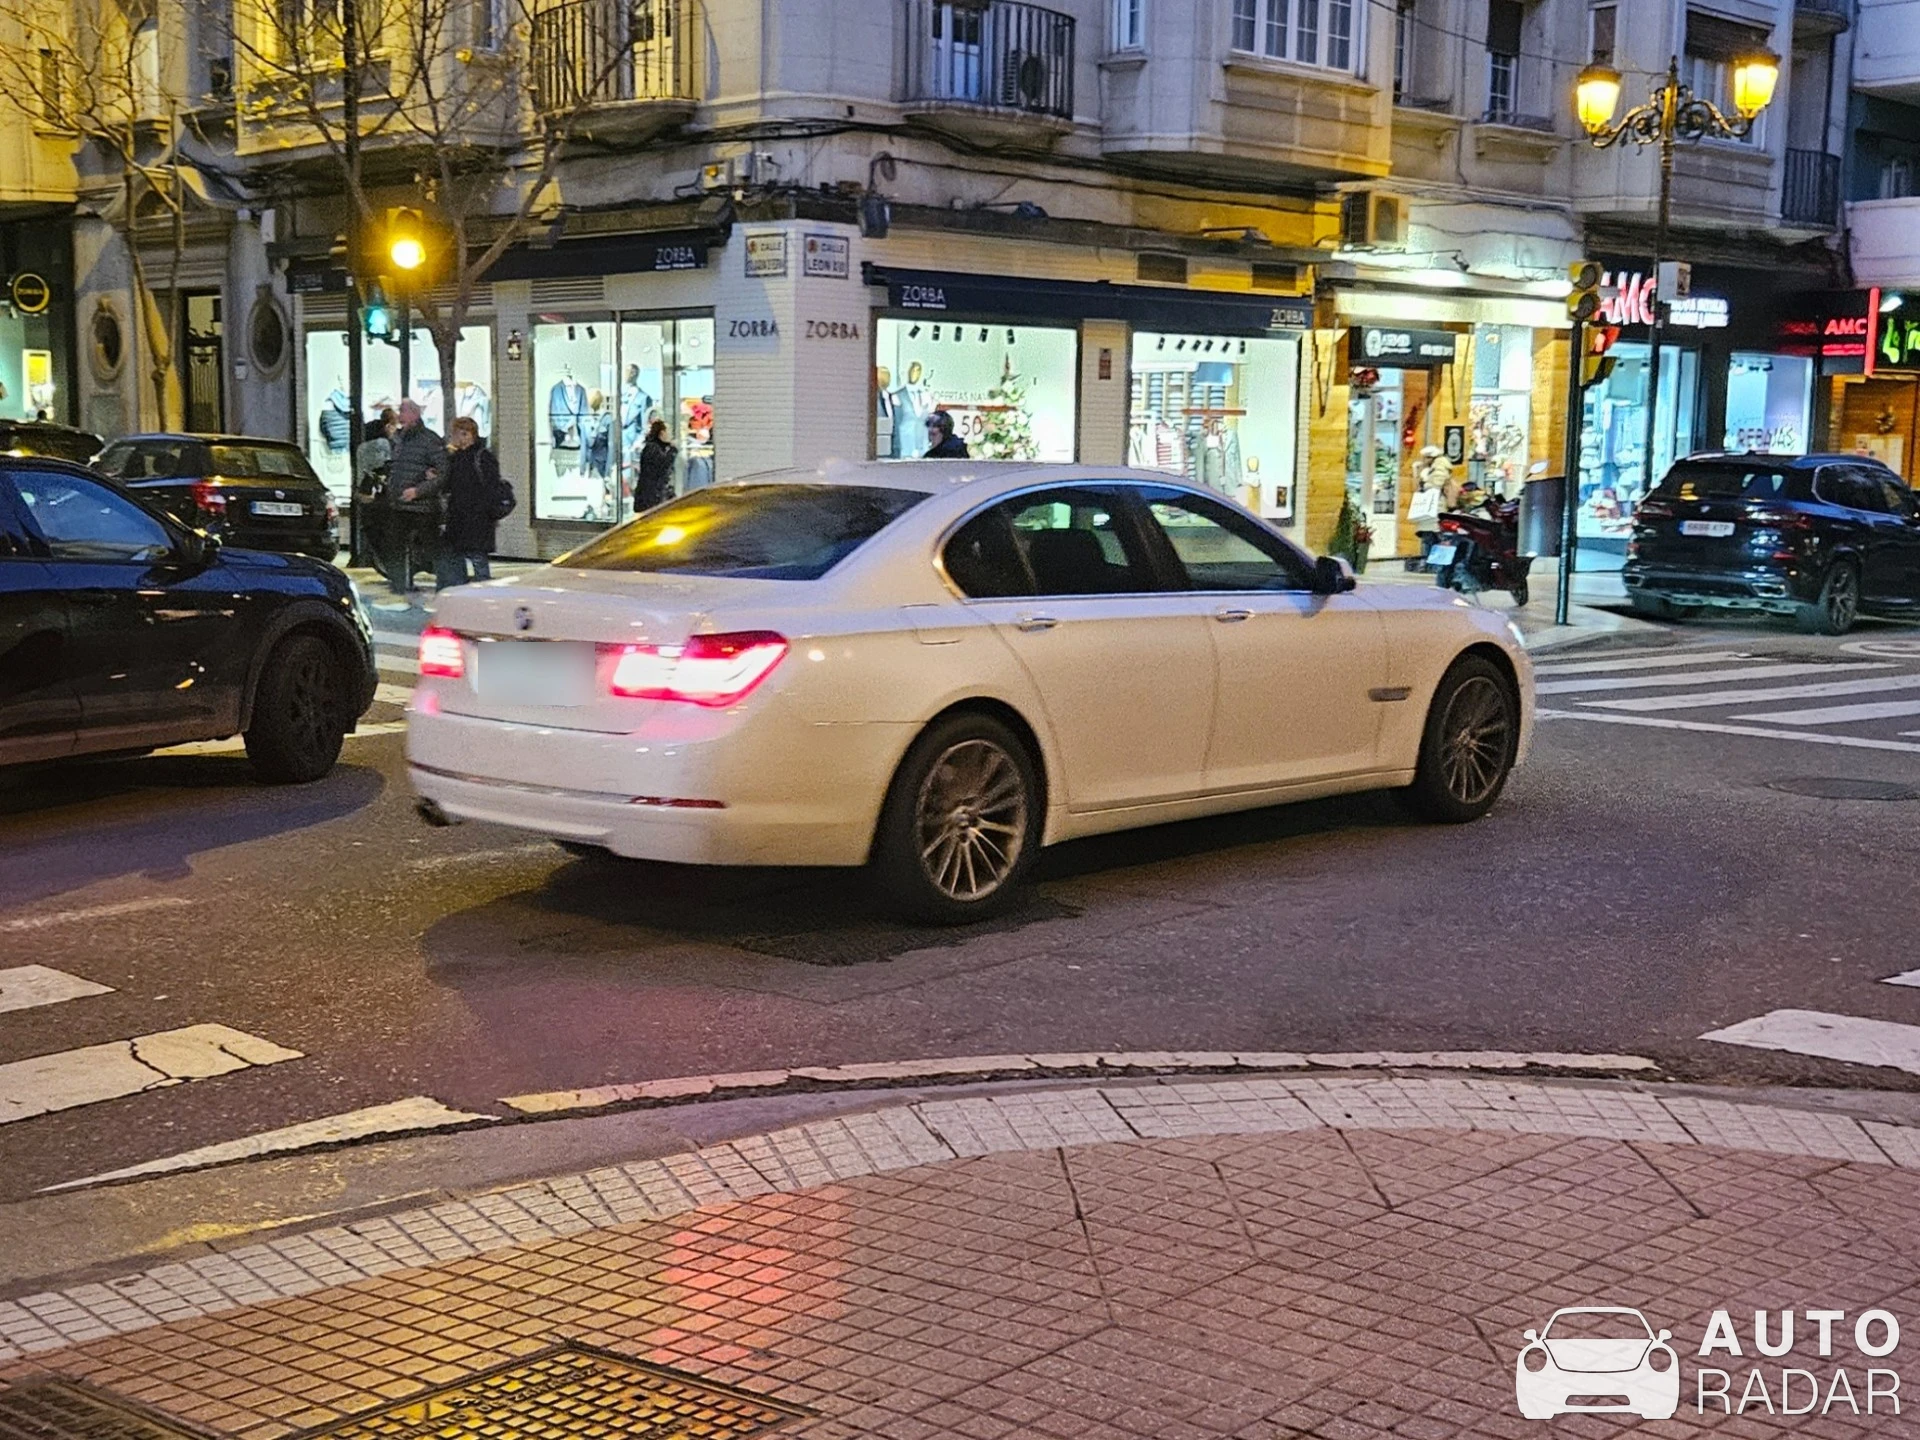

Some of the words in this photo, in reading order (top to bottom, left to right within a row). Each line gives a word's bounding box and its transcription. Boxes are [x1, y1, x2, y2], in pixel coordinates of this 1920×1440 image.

[655, 247, 696, 263] ZORBA
[902, 286, 946, 303] ZORBA
[1594, 271, 1656, 326] AMC
[1270, 309, 1306, 323] ZORBA
[729, 320, 779, 338] ZORBA
[806, 320, 860, 340] ZORBA
[1824, 318, 1867, 336] AMC
